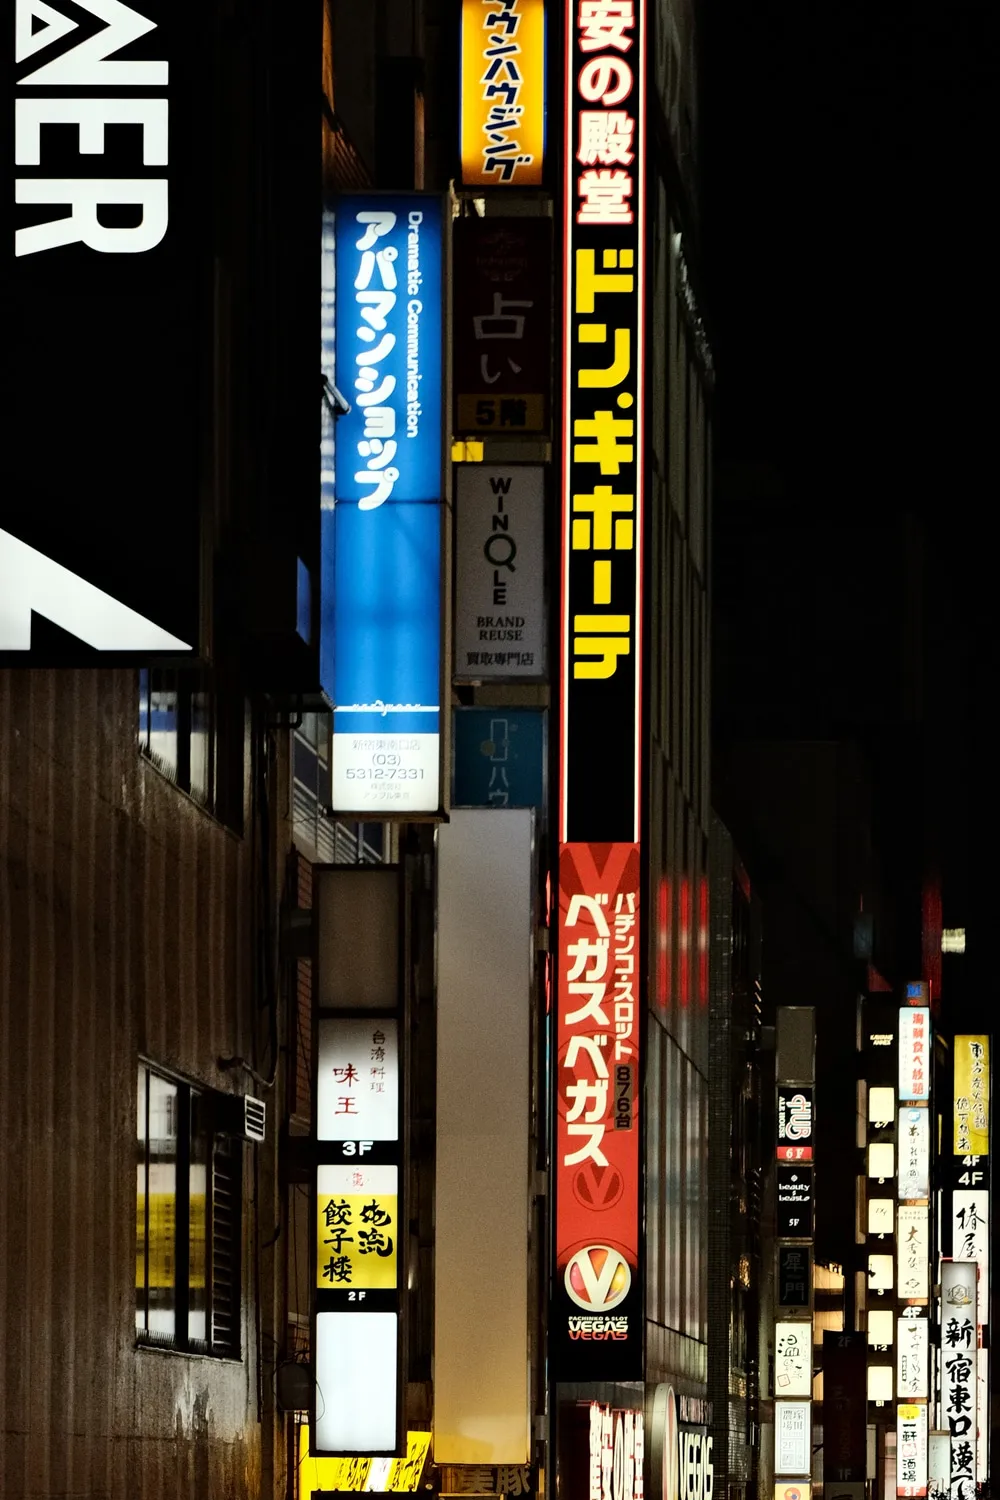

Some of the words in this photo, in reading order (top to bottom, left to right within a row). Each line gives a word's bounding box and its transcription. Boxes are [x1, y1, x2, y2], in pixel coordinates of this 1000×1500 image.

[478, 0, 533, 182] ウンハウジング
[407, 211, 424, 296] Dramatic
[472, 291, 534, 385] 占い
[354, 211, 401, 512] アパマンショップ
[407, 299, 424, 439] Communication
[476, 616, 526, 628] BRAND
[479, 629, 523, 641] REUSE
[371, 753, 402, 767] (03)
[345, 768, 425, 780] 5312-7331
[564, 892, 611, 1168] ベガスベガス
[370, 1030, 386, 1093] 台湾料理
[332, 1063, 360, 1115] 味王
[342, 1141, 374, 1156] 3F
[962, 1155, 980, 1166] 4F
[958, 1172, 984, 1186] 4F
[347, 1291, 367, 1301] 2F
[568, 1321, 629, 1333] VEGAS
